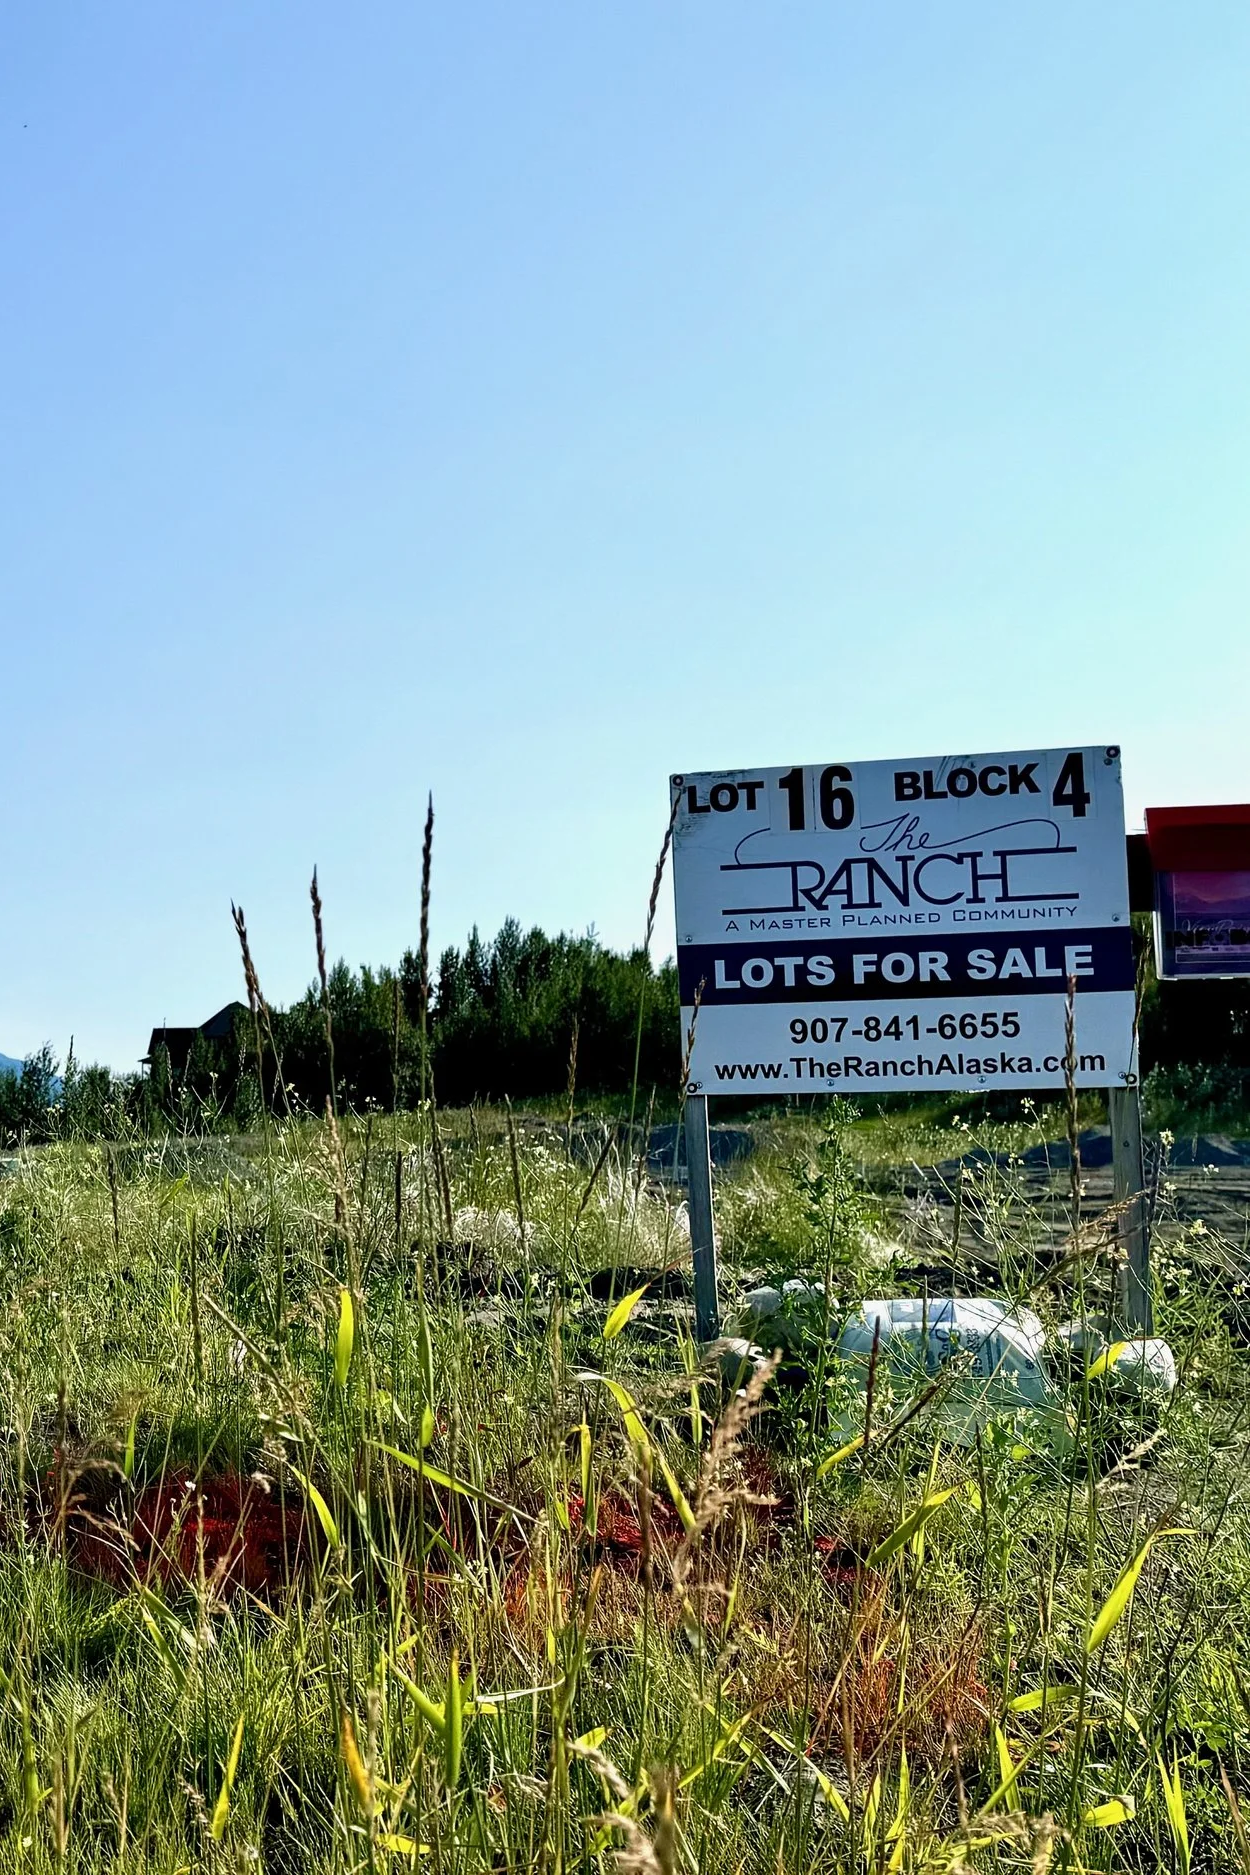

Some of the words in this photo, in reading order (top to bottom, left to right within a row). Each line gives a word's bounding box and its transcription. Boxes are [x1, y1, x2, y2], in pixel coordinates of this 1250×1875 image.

[686, 780, 765, 815] LOT
[778, 764, 855, 831] 16
[893, 762, 1042, 802] BLOCK
[1052, 751, 1091, 818] 4
[859, 812, 931, 852] The
[788, 849, 1012, 912] RANCH
[725, 919, 740, 932] A
[749, 917, 831, 931] MASTER
[842, 912, 941, 927] PLANNED
[952, 906, 1078, 922] COMMUNITY
[714, 955, 836, 989] LOTS
[852, 950, 952, 984] FOR
[966, 944, 1095, 980] SALE
[789, 1011, 1021, 1044] 907-841-6655
[714, 1052, 1106, 1080] www.TheRanchAlaska.com
